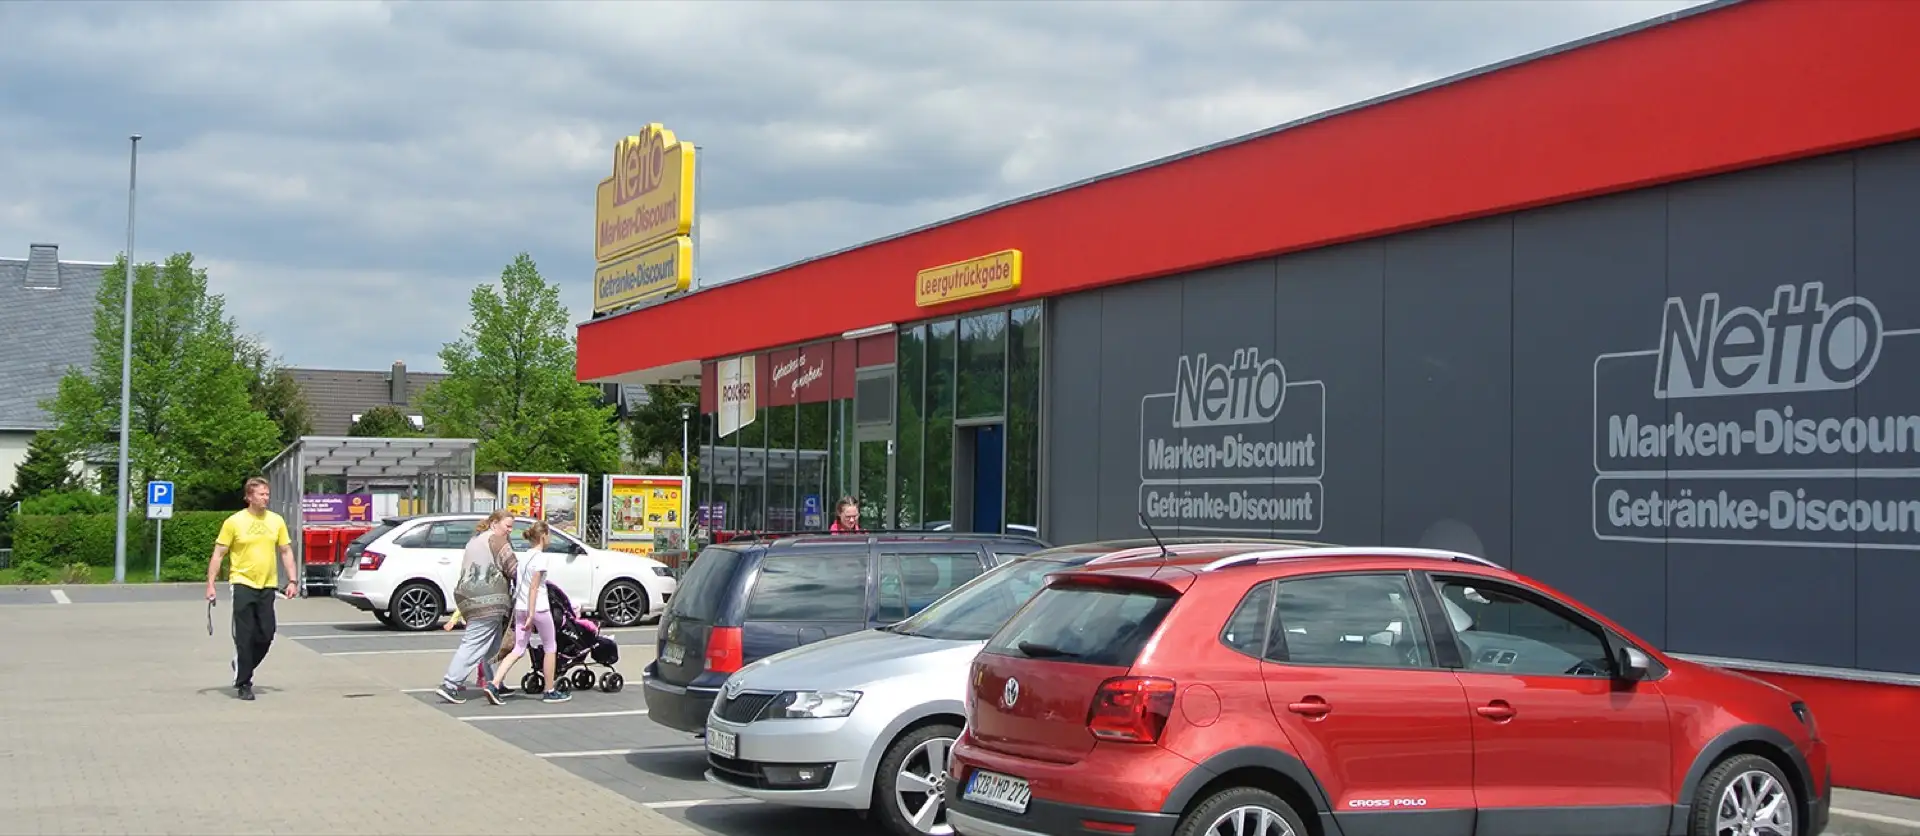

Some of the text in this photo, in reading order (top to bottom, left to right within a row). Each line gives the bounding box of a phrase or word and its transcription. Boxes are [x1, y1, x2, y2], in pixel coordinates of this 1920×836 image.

[614, 124, 664, 206] Netto
[600, 192, 677, 247] Marken-Discount
[599, 256, 675, 298] Getränke-Discount
[920, 257, 1010, 297] Leergutrückgabe
[1654, 281, 1883, 399] Netto
[1173, 347, 1286, 428] Netto
[1148, 433, 1316, 470] Marken-Discount
[154, 485, 168, 503] P
[1147, 489, 1313, 520] Getränke-Discount
[1007, 781, 1032, 805] 272
[1348, 798, 1427, 807] CROSS POLO
